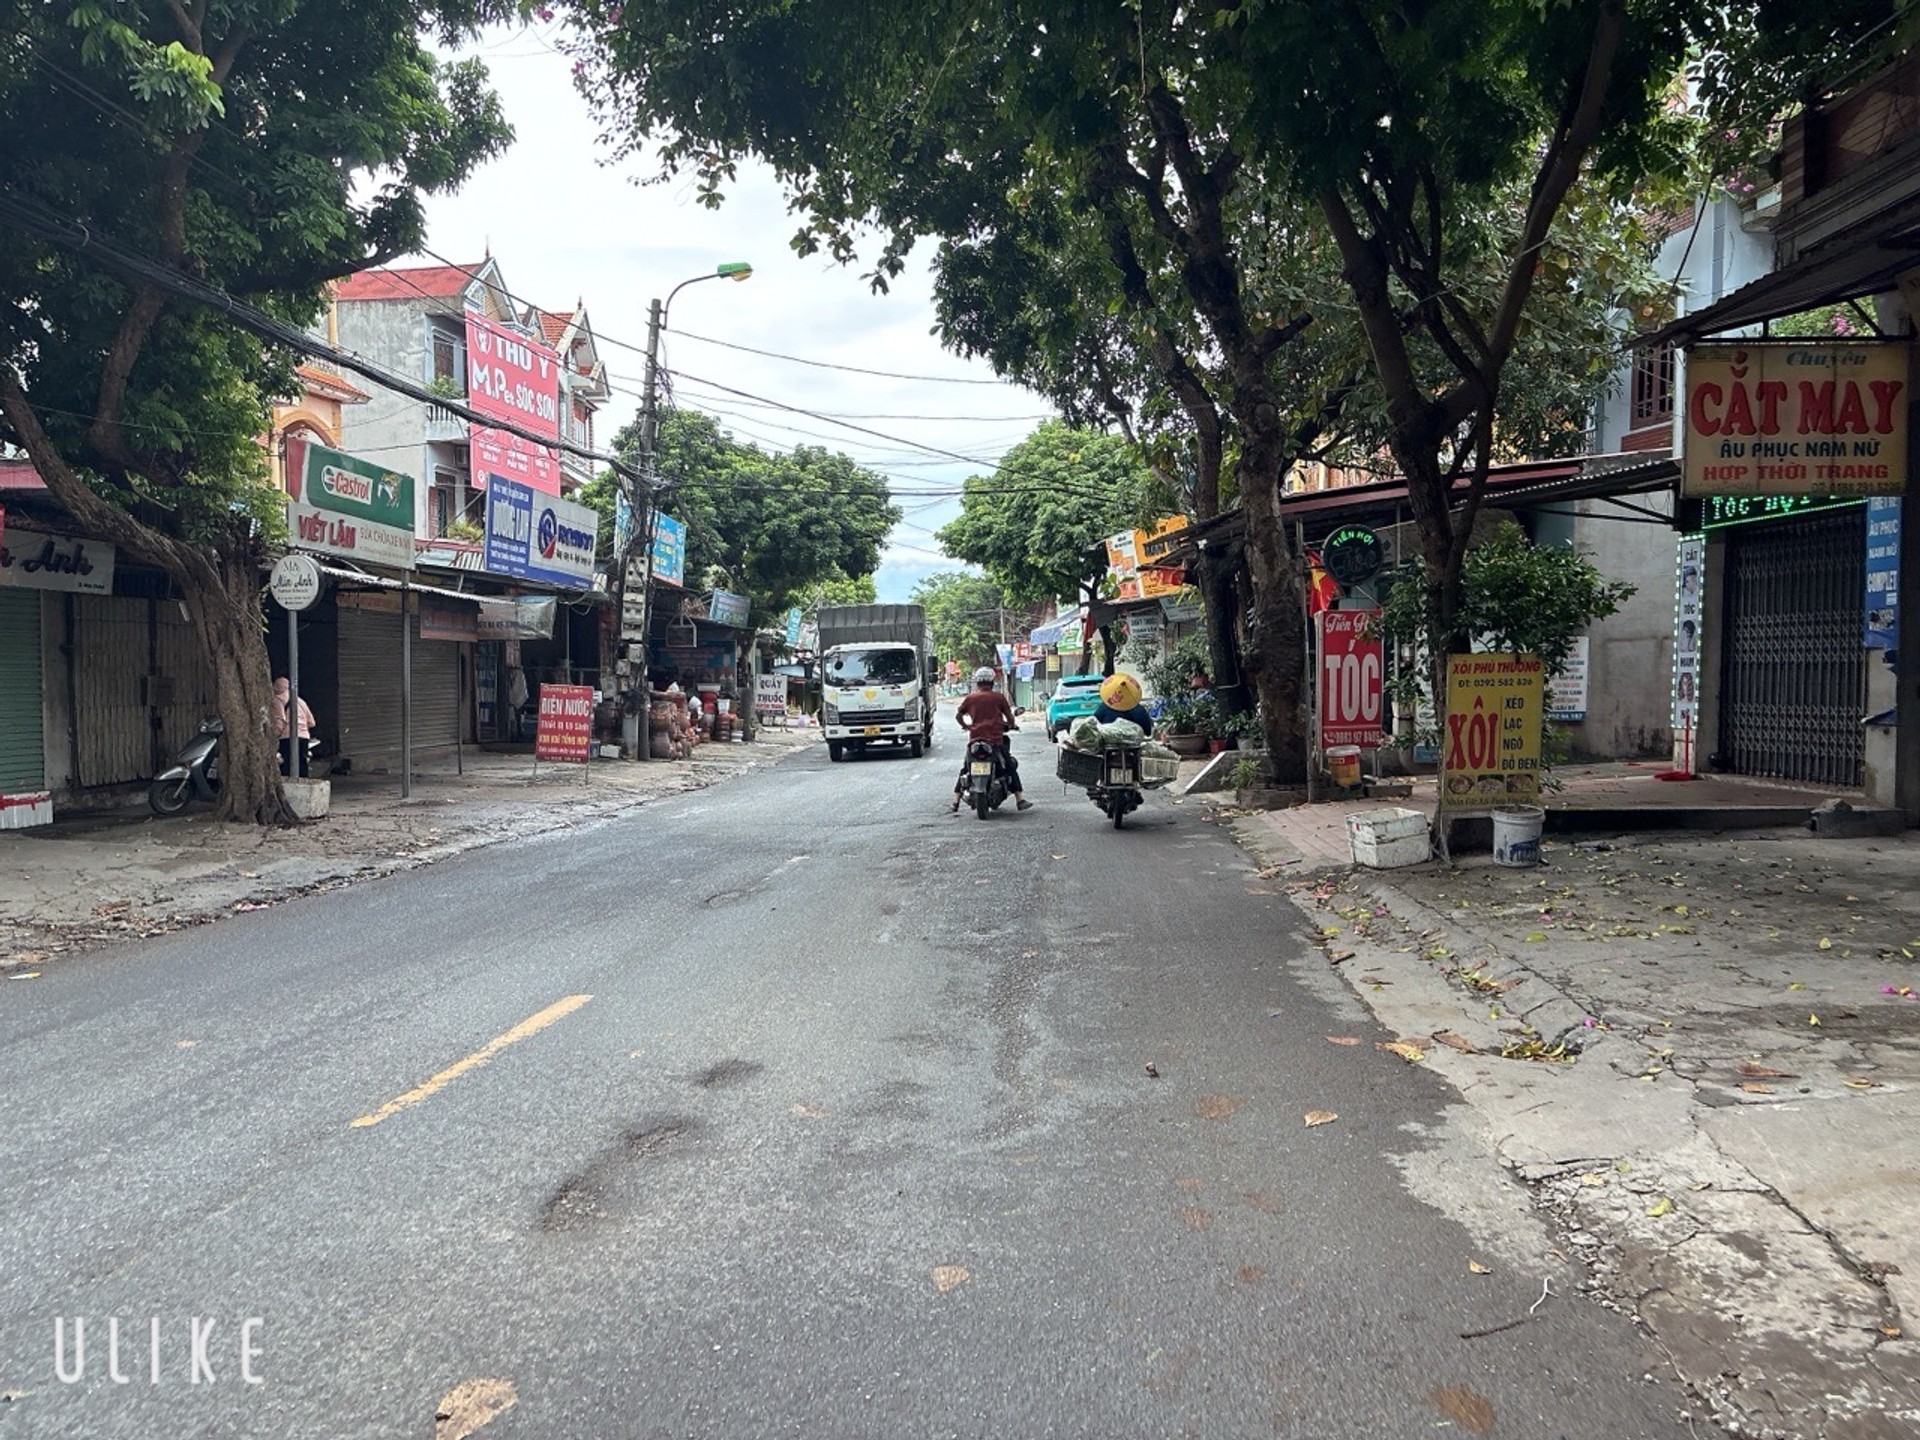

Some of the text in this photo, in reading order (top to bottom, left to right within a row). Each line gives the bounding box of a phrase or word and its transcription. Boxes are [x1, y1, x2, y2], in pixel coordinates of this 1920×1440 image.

[538, 351, 550, 378] Y
[1786, 351, 1868, 369] Chuyên
[516, 381, 536, 415] SÓC
[537, 392, 555, 422] SƠN
[1690, 351, 1904, 437] CẮT MAY
[1720, 438, 1881, 462] ÂU PHỤC NAM NỮ
[1703, 462, 1889, 483] HỢP THỜI TRANG
[335, 472, 369, 501] Castrol
[20, 540, 95, 576] Anh
[1325, 639, 1380, 722] TÓC
[1453, 660, 1472, 675] XÔI
[541, 694, 590, 719] ĐIỆN NƯỚC
[757, 691, 785, 703] THUỐC
[1446, 695, 1499, 771] XÔI
[1504, 717, 1522, 732] LẠC
